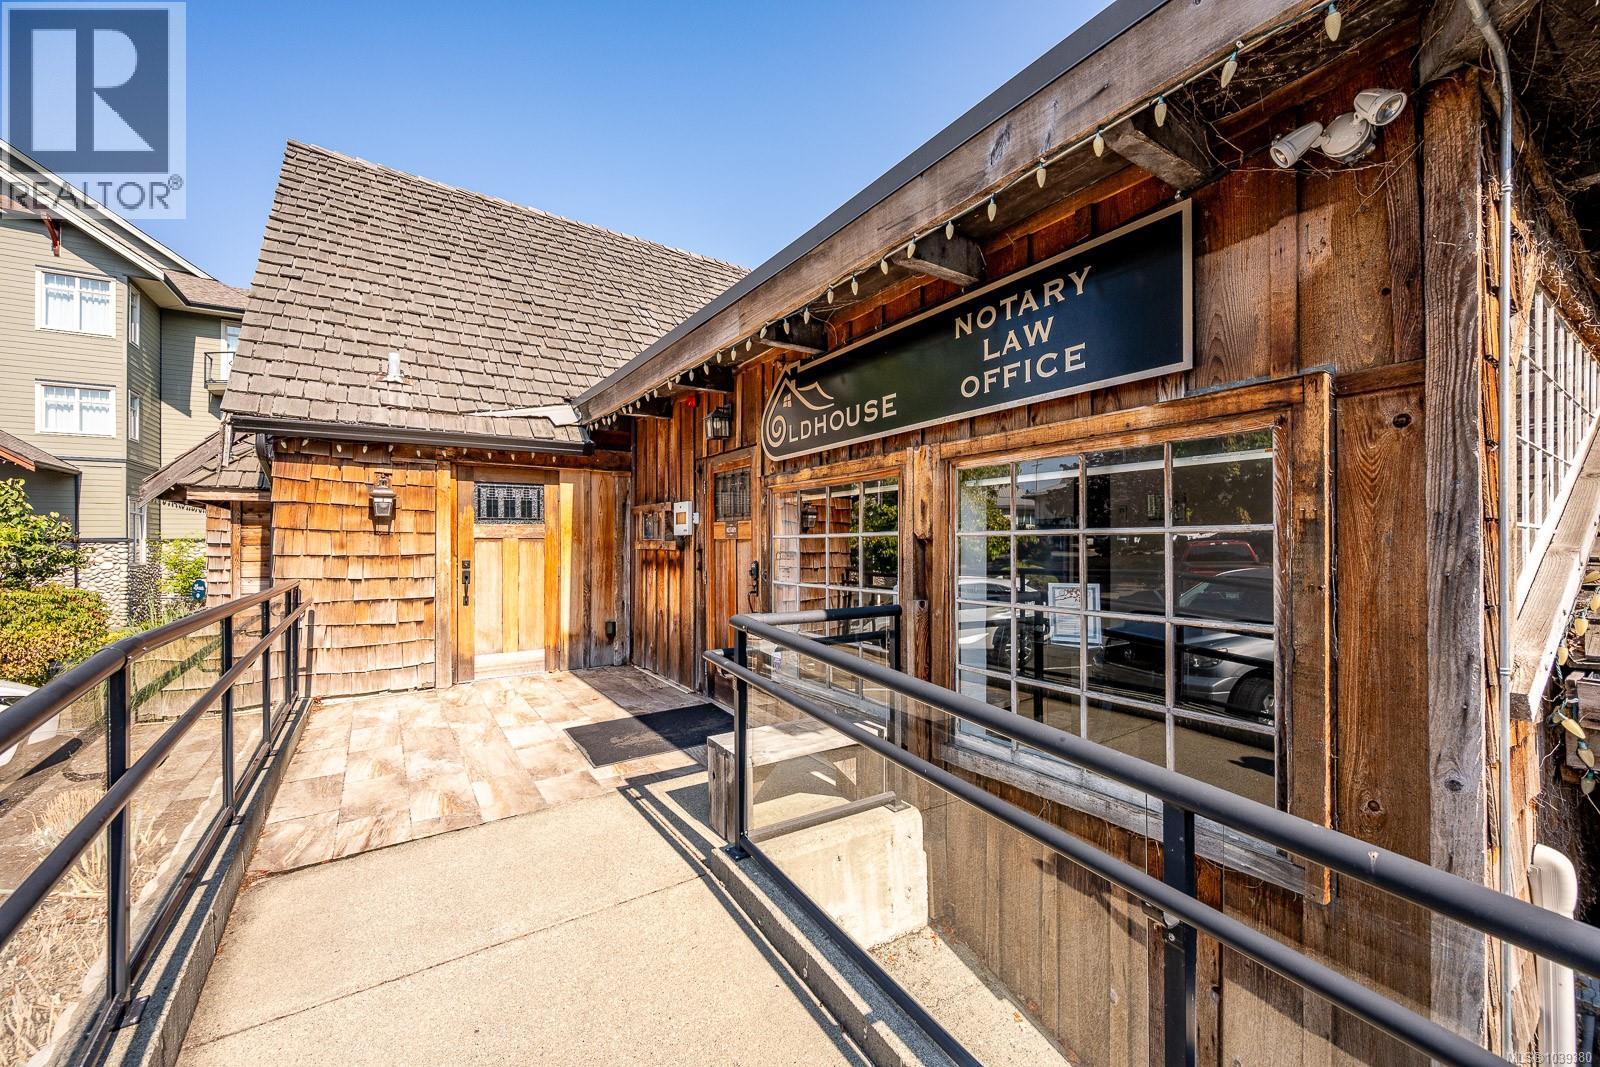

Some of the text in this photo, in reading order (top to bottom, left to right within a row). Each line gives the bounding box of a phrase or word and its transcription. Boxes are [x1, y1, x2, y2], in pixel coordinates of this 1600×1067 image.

[954, 265, 1092, 339] NOTARY
[983, 316, 1054, 361] LAW
[960, 342, 1086, 398] OFFICE
